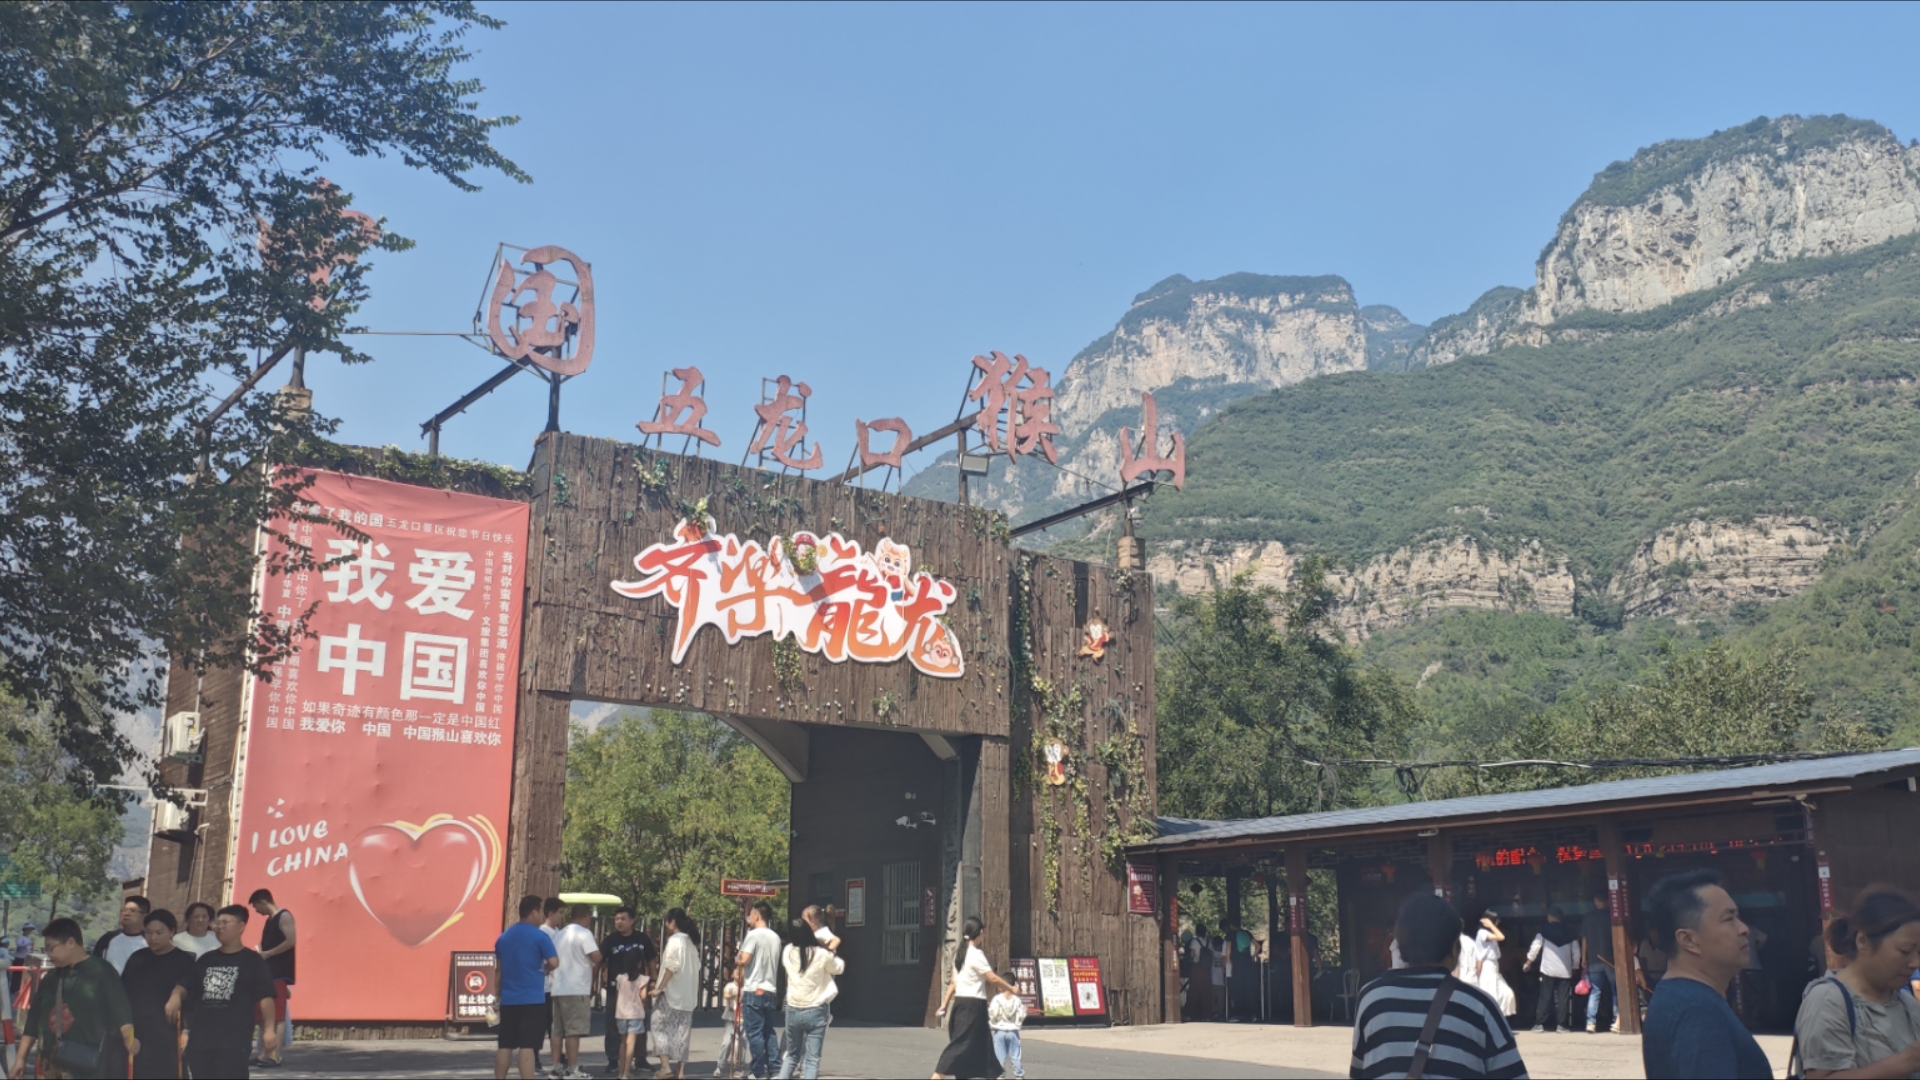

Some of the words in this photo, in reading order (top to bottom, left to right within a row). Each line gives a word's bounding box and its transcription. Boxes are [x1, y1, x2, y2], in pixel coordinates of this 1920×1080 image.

[387, 517, 515, 546] 五龙口景区祝您节日快乐
[321, 539, 476, 621] 我爱
[496, 551, 513, 650] 吾对你蛮有意思滴
[317, 623, 468, 704] 中国
[475, 616, 491, 713] 文旅集团喜欢你中国
[300, 717, 347, 735] 我爱你
[362, 722, 392, 738] 中国
[403, 725, 502, 747] 中国猴山喜欢你
[302, 700, 501, 730] 如果奇迹有颜色那一定是中国红
[251, 832, 259, 854] I
[267, 841, 349, 877] CHINA
